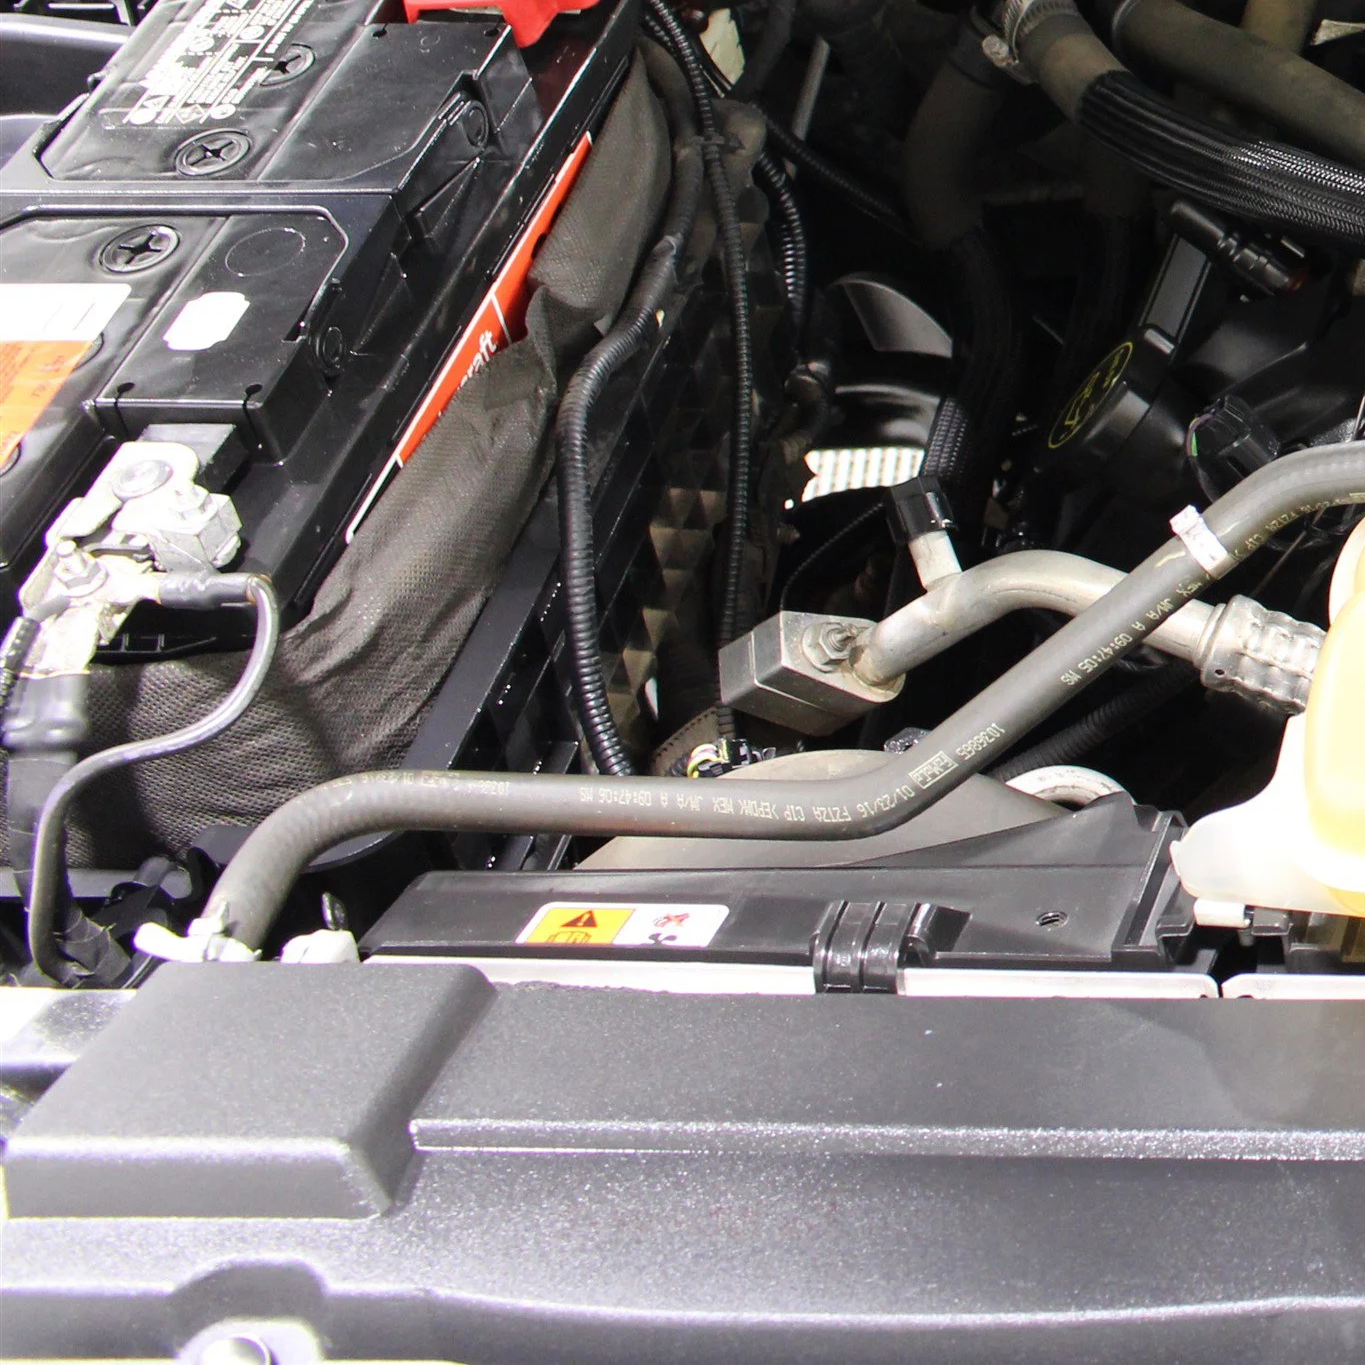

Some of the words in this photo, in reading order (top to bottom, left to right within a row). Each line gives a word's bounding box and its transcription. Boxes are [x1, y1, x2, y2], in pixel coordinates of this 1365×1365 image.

[1131, 620, 1147, 632] A
[1077, 632, 1134, 674] 09:47:05
[1060, 669, 1083, 686] MS
[955, 722, 1006, 761] 1036865
[579, 786, 594, 803] MS
[599, 787, 653, 807] 09:47:06
[660, 791, 669, 806] A
[856, 784, 916, 819] 01/23/16
[712, 796, 735, 814] MEX
